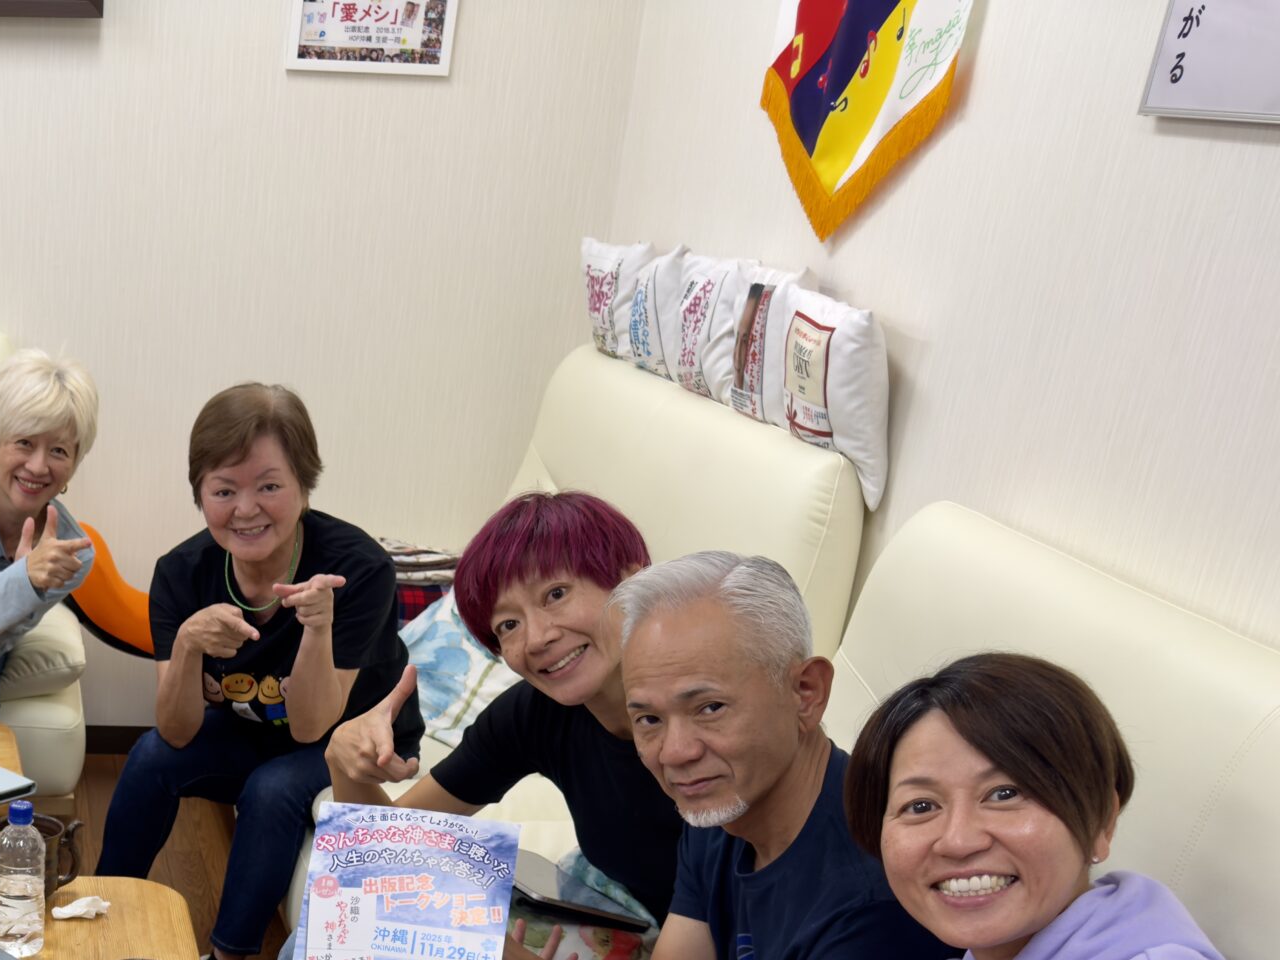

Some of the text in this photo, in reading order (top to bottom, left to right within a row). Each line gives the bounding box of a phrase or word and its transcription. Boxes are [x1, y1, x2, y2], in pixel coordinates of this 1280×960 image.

[331, 1, 399, 25] 「愛メシ」
[359, 815, 377, 824] 人生
[380, 812, 428, 824] 面白くなって
[363, 873, 434, 895] 出版記念
[384, 891, 487, 912] トークショー
[373, 927, 408, 945] 沖縄
[421, 933, 453, 944] 2025年
[371, 943, 407, 953] OKINAWA
